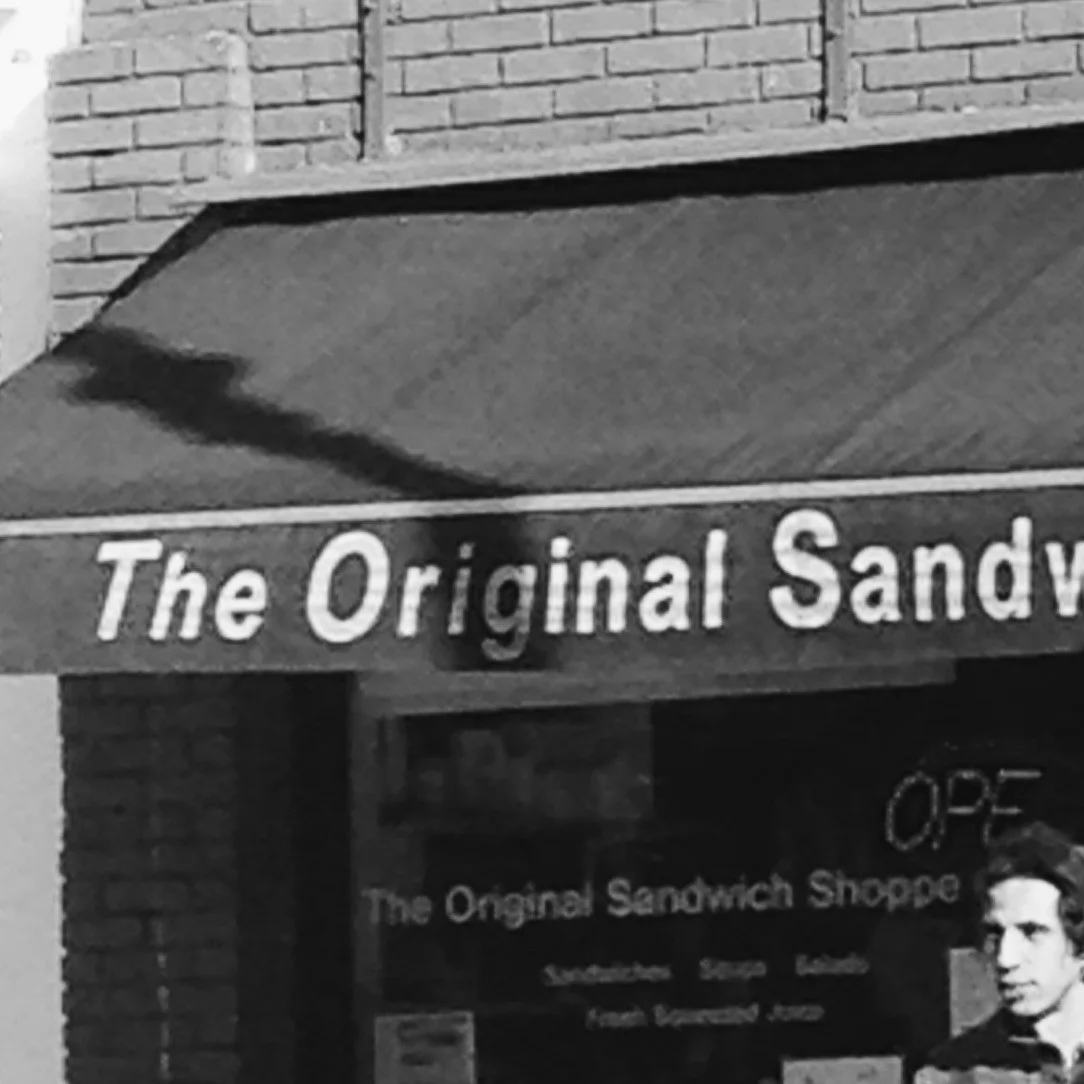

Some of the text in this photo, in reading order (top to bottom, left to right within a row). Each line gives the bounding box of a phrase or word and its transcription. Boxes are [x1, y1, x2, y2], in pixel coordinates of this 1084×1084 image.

[96, 538, 268, 640] The
[306, 529, 728, 661] Original
[362, 867, 960, 930] The Original Sandwich Shoppe
